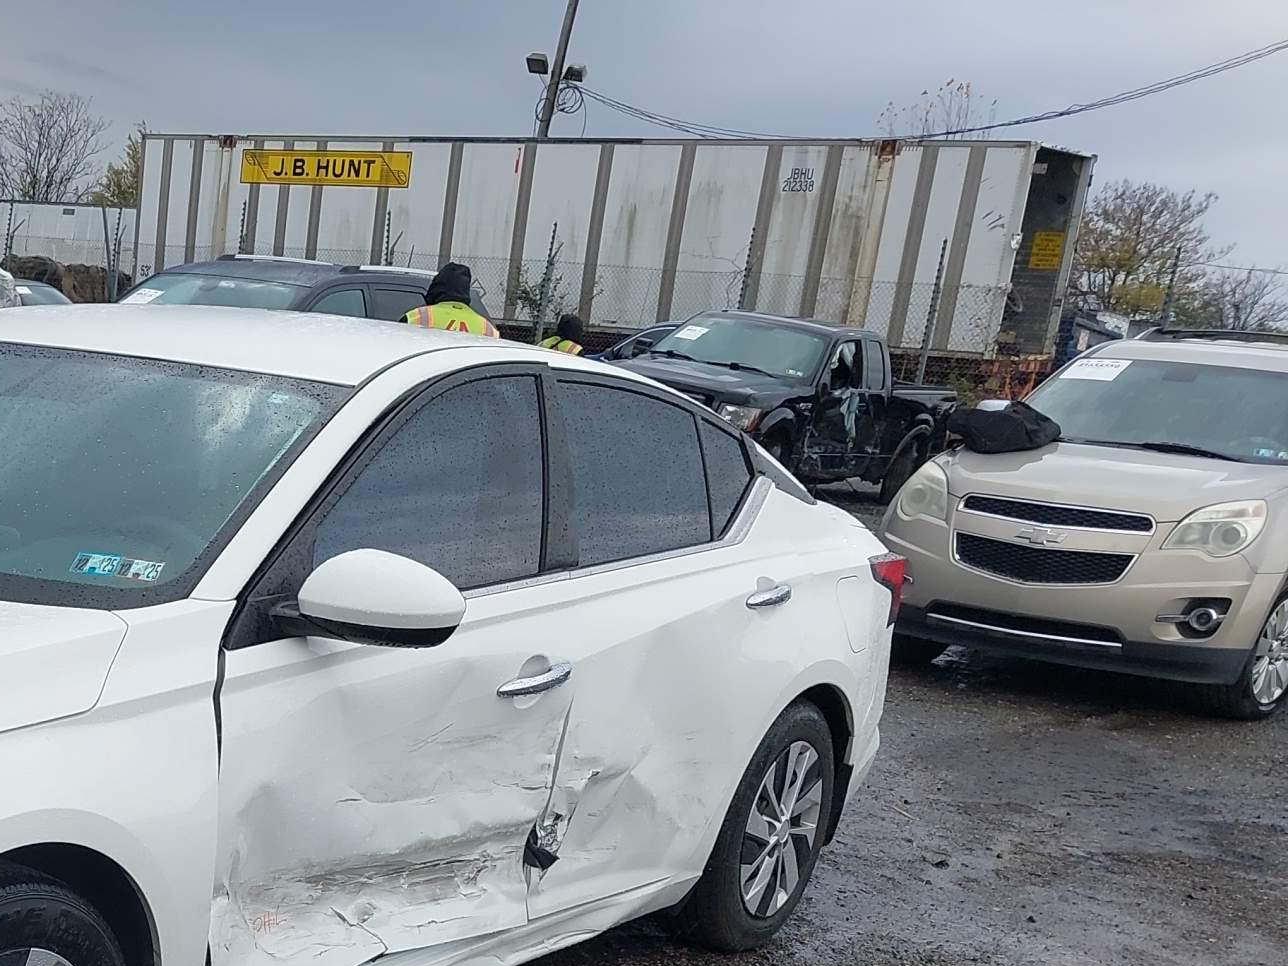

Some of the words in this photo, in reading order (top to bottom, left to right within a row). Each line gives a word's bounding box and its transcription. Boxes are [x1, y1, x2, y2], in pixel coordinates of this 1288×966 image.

[273, 158, 309, 177] J.B.
[316, 159, 375, 178] HUNT
[786, 167, 815, 180] JBHU
